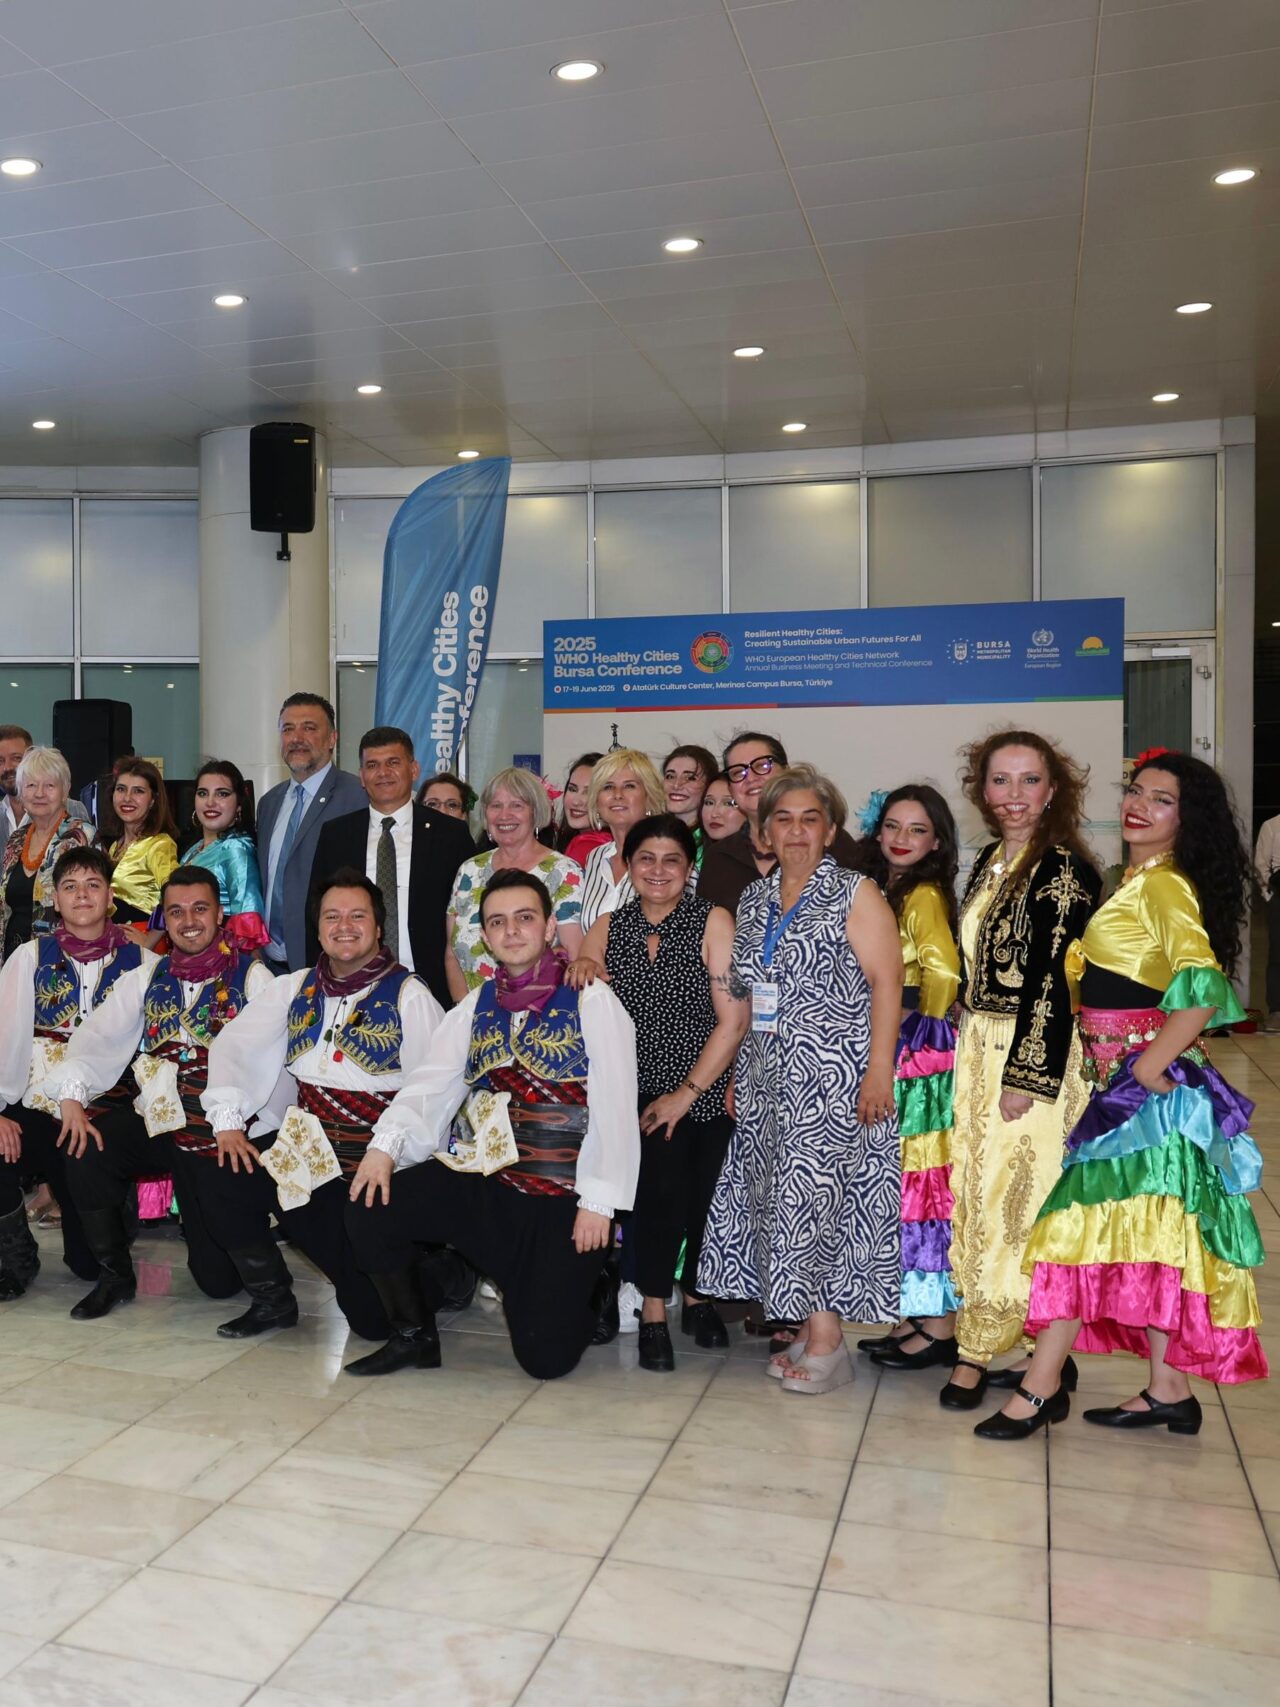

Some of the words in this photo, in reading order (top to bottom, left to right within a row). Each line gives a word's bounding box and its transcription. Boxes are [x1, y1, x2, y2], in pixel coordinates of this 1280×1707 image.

[432, 591, 460, 677] Cities
[744, 630, 781, 638] Resilient
[781, 628, 815, 638] Healthy
[816, 628, 844, 636] Cities:
[553, 637, 597, 652] 2025
[744, 639, 782, 649] Creating
[782, 638, 833, 647] Sustainable
[834, 637, 860, 645] Urban
[861, 636, 894, 644] Futures
[895, 635, 910, 643] For
[910, 634, 922, 642] All
[554, 653, 589, 665] WHO
[592, 651, 641, 665] Healthy
[643, 650, 680, 662] Cities
[744, 655, 766, 663] WHO
[766, 654, 806, 664] European
[807, 653, 839, 663] Healthy
[840, 652, 864, 660] Cities
[865, 651, 900, 659] Network
[553, 665, 595, 678] Bursa
[597, 664, 682, 677] Conference
[744, 664, 771, 672] Annual
[803, 663, 834, 671] Meeting
[888, 660, 933, 668] Conference
[598, 684, 616, 692] 2025
[660, 683, 687, 691] Culture
[688, 682, 715, 690] Center,
[715, 680, 745, 688] Merinos
[746, 680, 779, 689] Campus
[780, 679, 804, 688] Bursa,
[805, 678, 833, 687] Türkiye
[430, 683, 462, 775] ealthy
